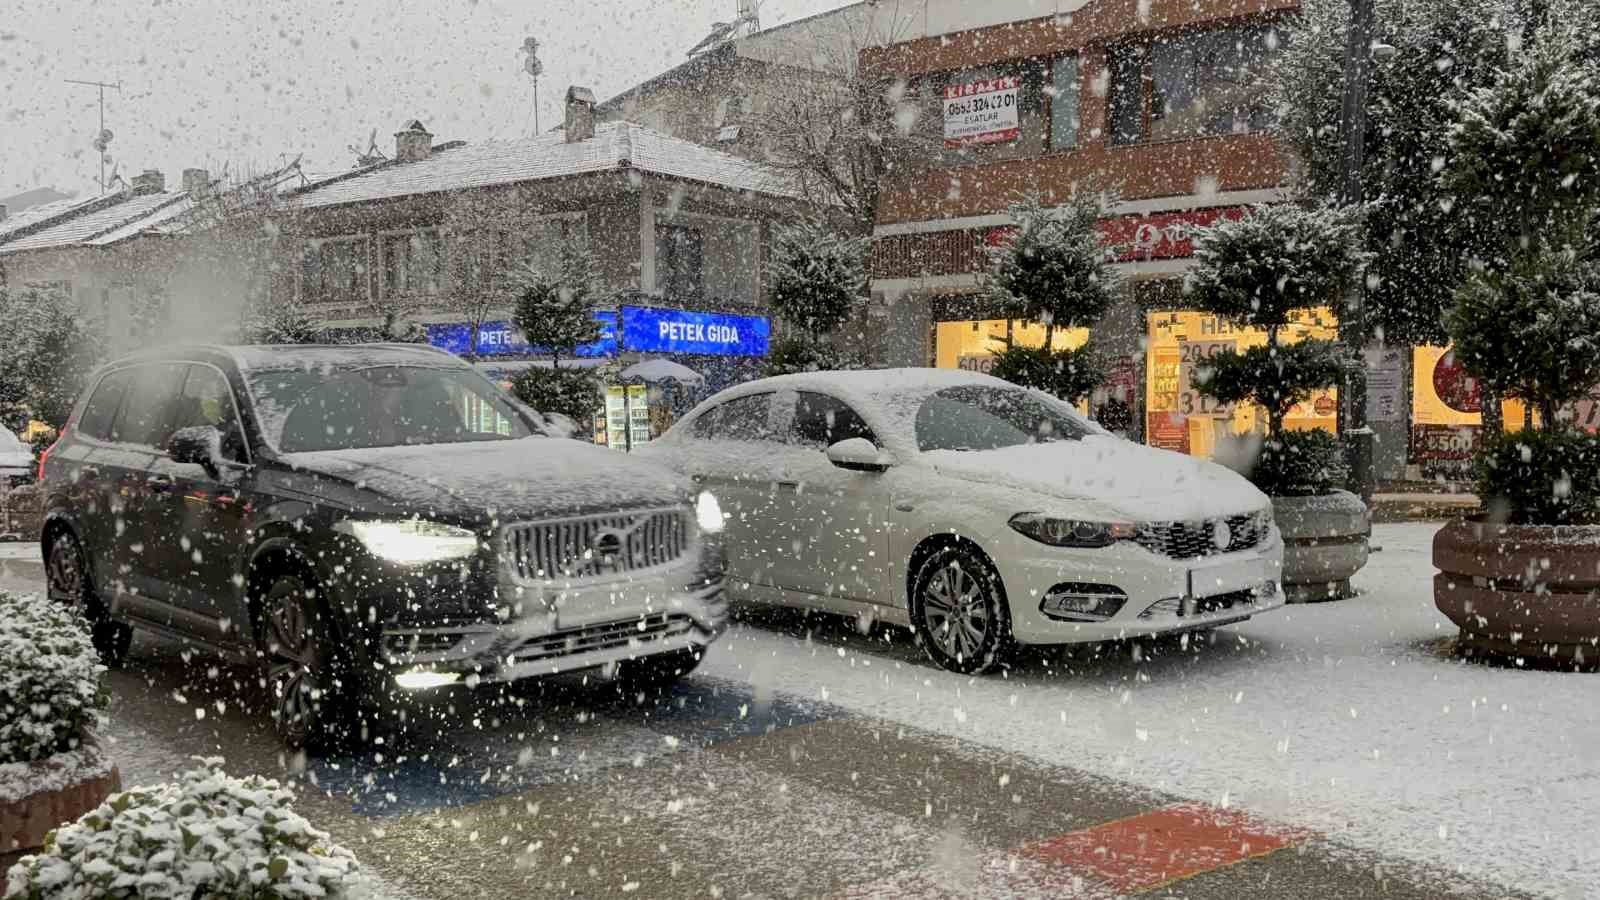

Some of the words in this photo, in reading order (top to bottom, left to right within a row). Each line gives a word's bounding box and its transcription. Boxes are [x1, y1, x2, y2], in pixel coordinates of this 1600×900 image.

[1004, 94, 1015, 107] 01
[658, 320, 704, 342] PETEK
[707, 325, 740, 344] GIDA
[1201, 318, 1234, 335] HE
[480, 330, 520, 345] PETE
